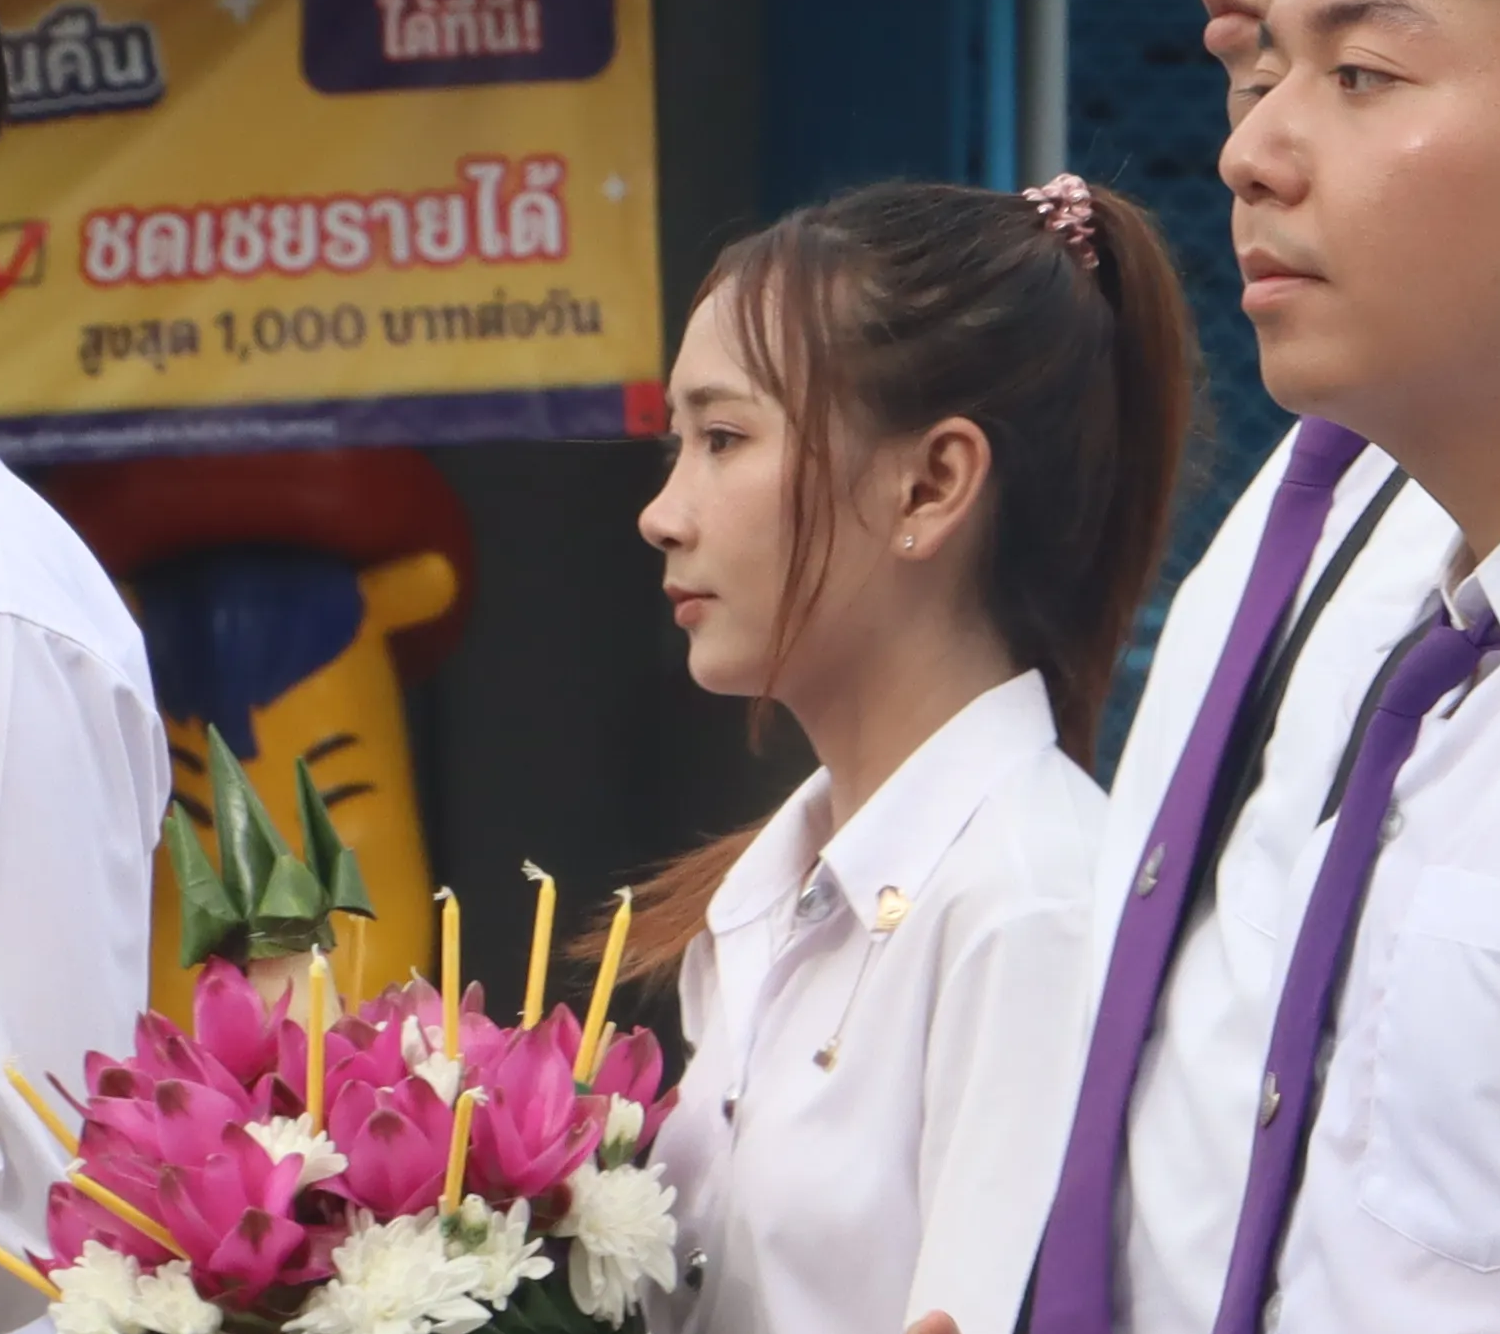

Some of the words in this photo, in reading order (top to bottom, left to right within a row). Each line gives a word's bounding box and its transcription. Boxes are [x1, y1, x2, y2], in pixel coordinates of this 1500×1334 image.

[82, 161, 563, 284] ชดเชยรายได้
[214, 300, 367, 363] 1,000
[380, 288, 604, 347] บาทต่อวัน
